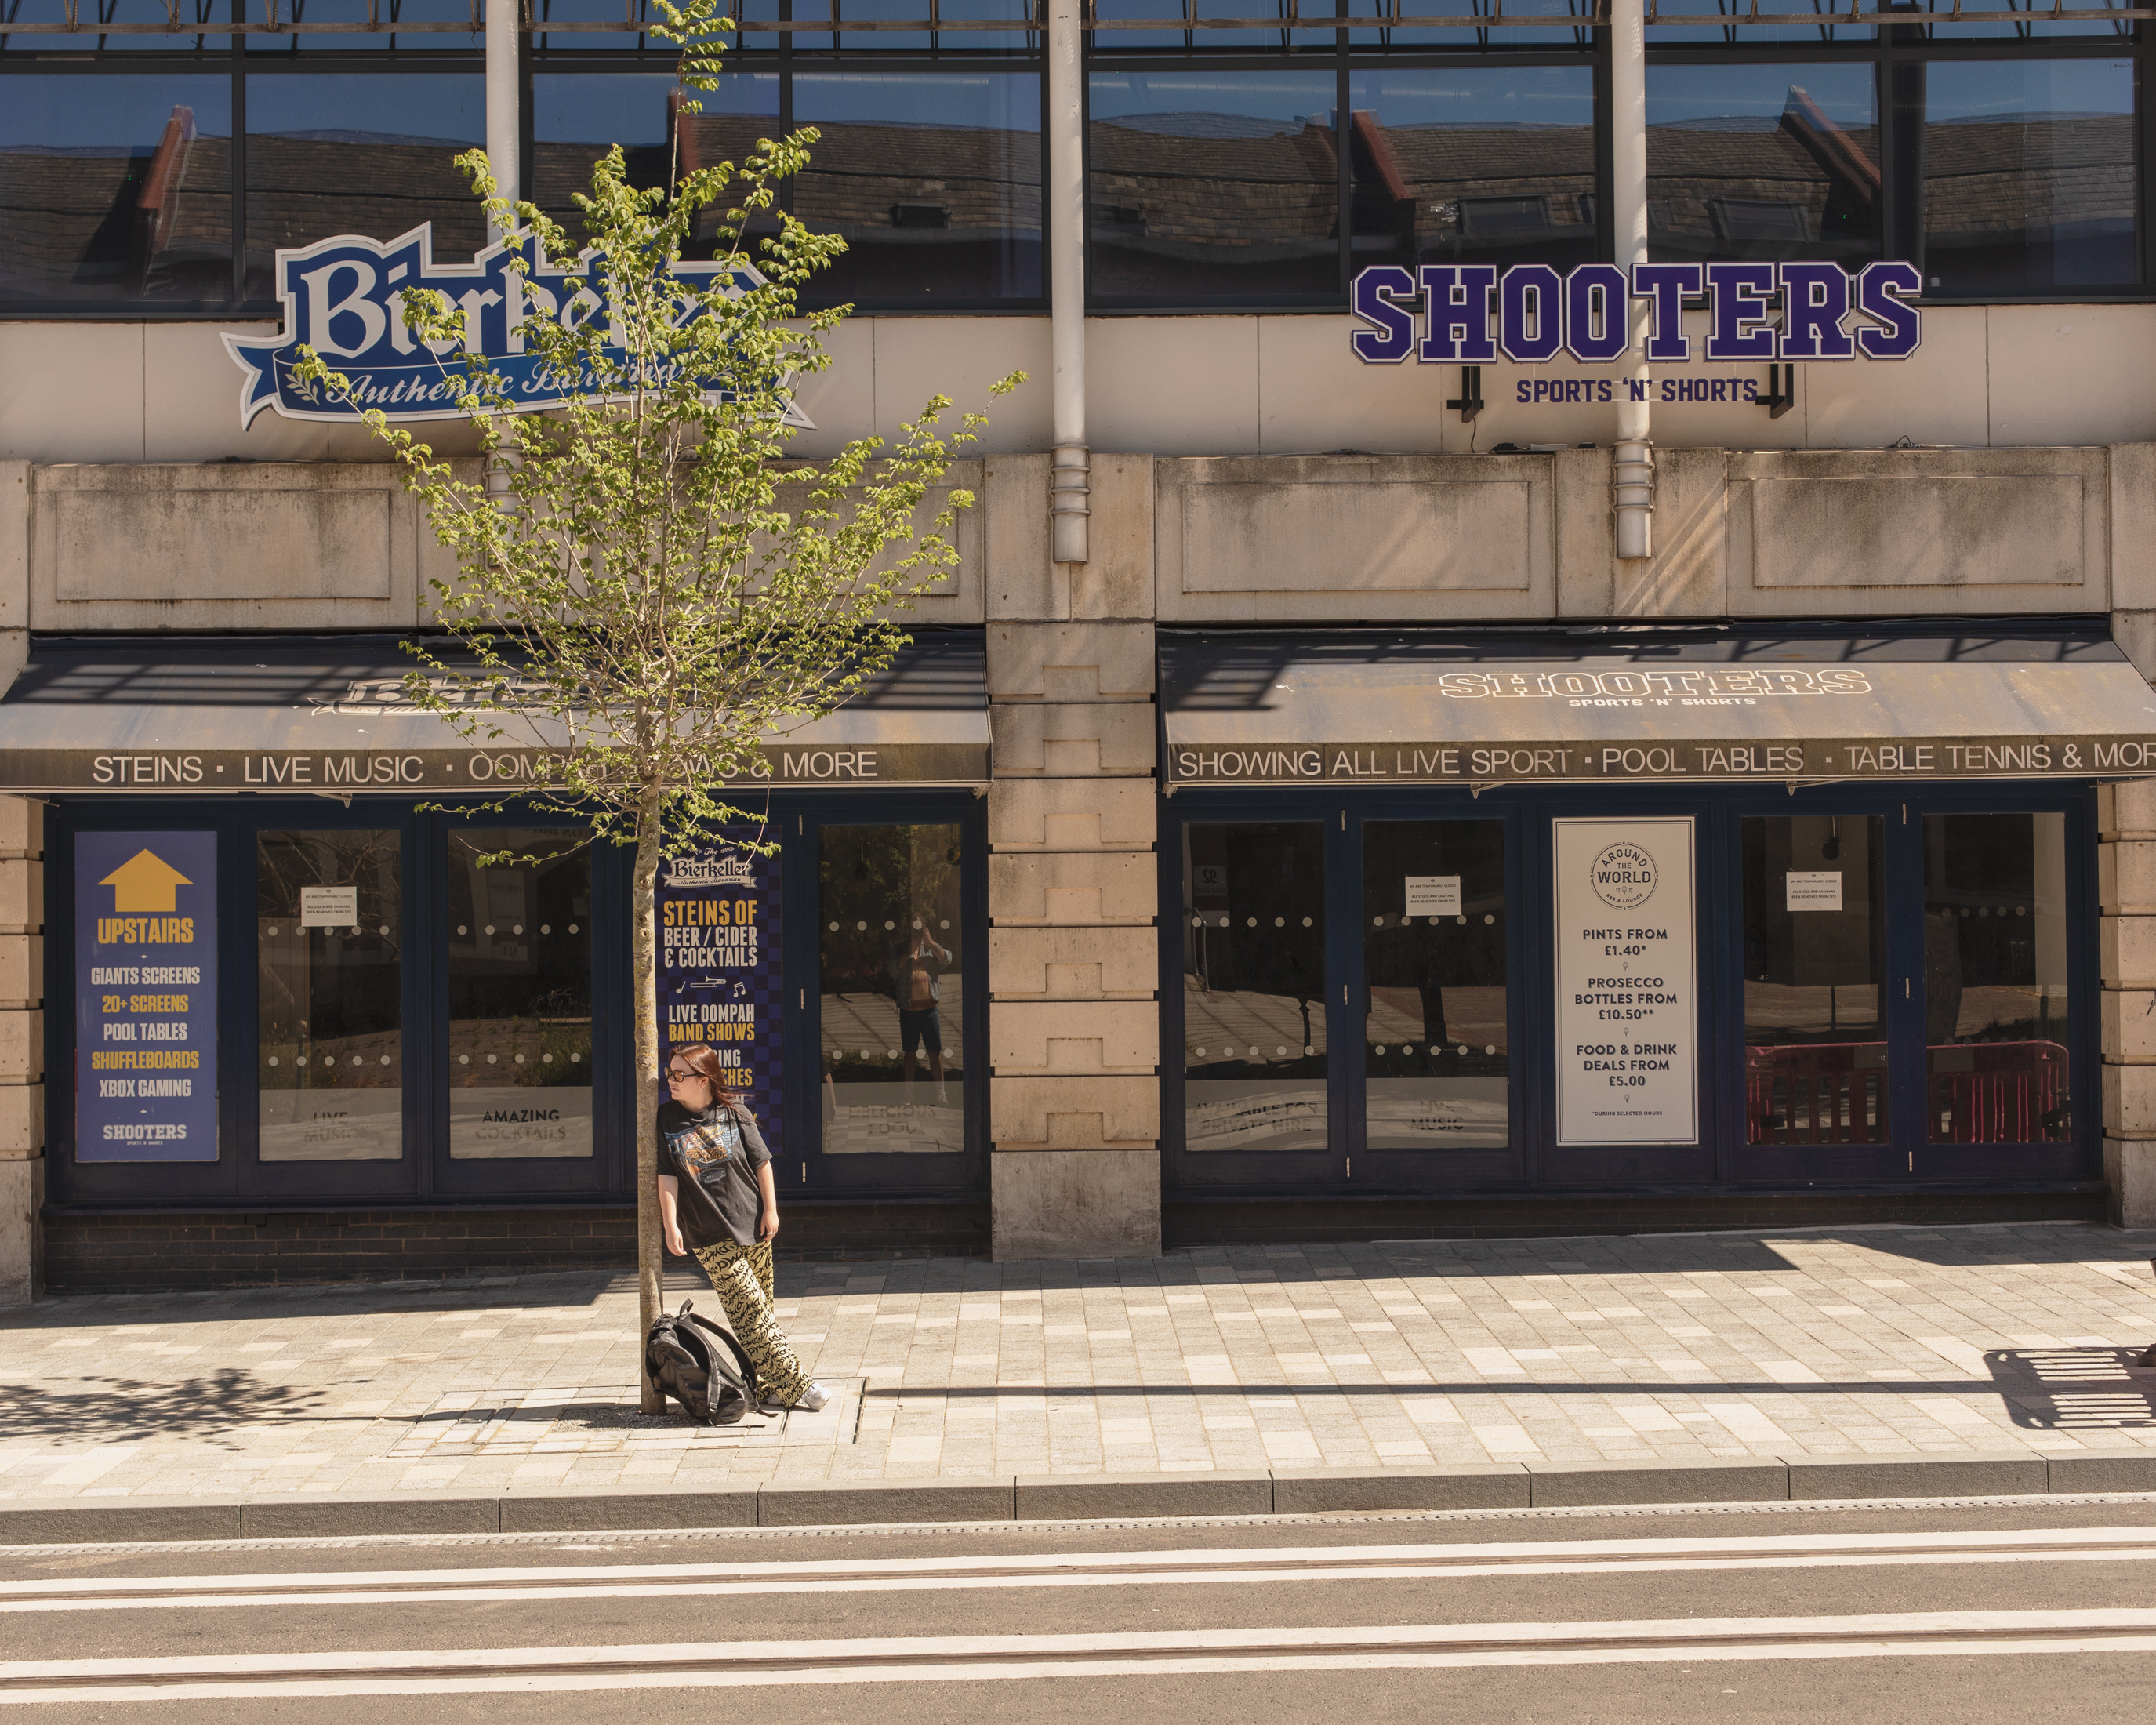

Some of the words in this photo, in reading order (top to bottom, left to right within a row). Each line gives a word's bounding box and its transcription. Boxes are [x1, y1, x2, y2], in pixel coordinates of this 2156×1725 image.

[1351, 260, 1922, 365] SHOOTERS
[325, 367, 514, 405] Authentic
[1516, 380, 1613, 403] SPORTS
[1662, 379, 1759, 402] SHORTS
[1439, 670, 1872, 698] SHOOTERS
[93, 756, 203, 783] STEINS
[245, 756, 312, 783] LIVE
[325, 755, 423, 782] MUSIC
[784, 751, 877, 778] MORE
[1178, 750, 1321, 776] SHOWING
[1331, 750, 1386, 775] ALL
[1397, 750, 1460, 775] LIVE
[1471, 749, 1573, 775] SPORT
[1603, 748, 1686, 772] POOL
[1695, 747, 1804, 772] TABLES
[1844, 746, 1934, 771] TABLE
[1945, 744, 2051, 769] TENNIS
[2062, 744, 2082, 768] &
[703, 847, 718, 855] The
[1602, 848, 1647, 868] AROUND
[674, 860, 749, 877] Bierkeller
[1597, 871, 1651, 884] WORLD
[1606, 893, 1616, 902] BAR
[1622, 892, 1643, 903] LOUNGE
[663, 901, 729, 926] STEINS
[735, 900, 757, 924] OF
[97, 918, 194, 944] UPSTAIRS
[664, 928, 699, 947] BEER
[715, 926, 757, 946] CIDER
[1583, 929, 1622, 940] PINTS
[1627, 928, 1668, 940] FROM
[664, 948, 675, 968] &
[678, 947, 757, 968] COCKTAILS
[91, 967, 139, 985] GIANTS
[141, 967, 200, 985] SCREENS
[1588, 977, 1664, 989] PROSECCO
[102, 995, 128, 1013] 20+
[130, 994, 189, 1012] SCREENS
[1574, 993, 1632, 1005] BOTTLES
[1637, 993, 1678, 1004] FROM
[669, 1004, 698, 1023] LIVE
[701, 1004, 755, 1022] OOMPAH
[103, 1023, 137, 1041] POOL
[140, 1022, 187, 1041] TABLES
[669, 1024, 704, 1042] BAND
[706, 1023, 755, 1041] SHOWS
[1576, 1044, 1616, 1055] FOOD
[1620, 1044, 1630, 1055] &
[1633, 1044, 1677, 1055] DRINK
[92, 1051, 199, 1070] SHUFFLEBOARDS
[1584, 1060, 1625, 1071] DEALS
[1630, 1059, 1670, 1071] FROM
[99, 1080, 135, 1098] XBOX
[138, 1079, 191, 1097] GAMING
[1608, 1075, 1646, 1087] £5.00
[313, 1112, 348, 1124] LIVE
[482, 1109, 560, 1123] AMAZING
[849, 1105, 935, 1118] DELICIOUS
[103, 1124, 187, 1140] SHOOTERS
[1411, 1117, 1464, 1130] MUSIC
[475, 1126, 567, 1140] COCKTAILS
